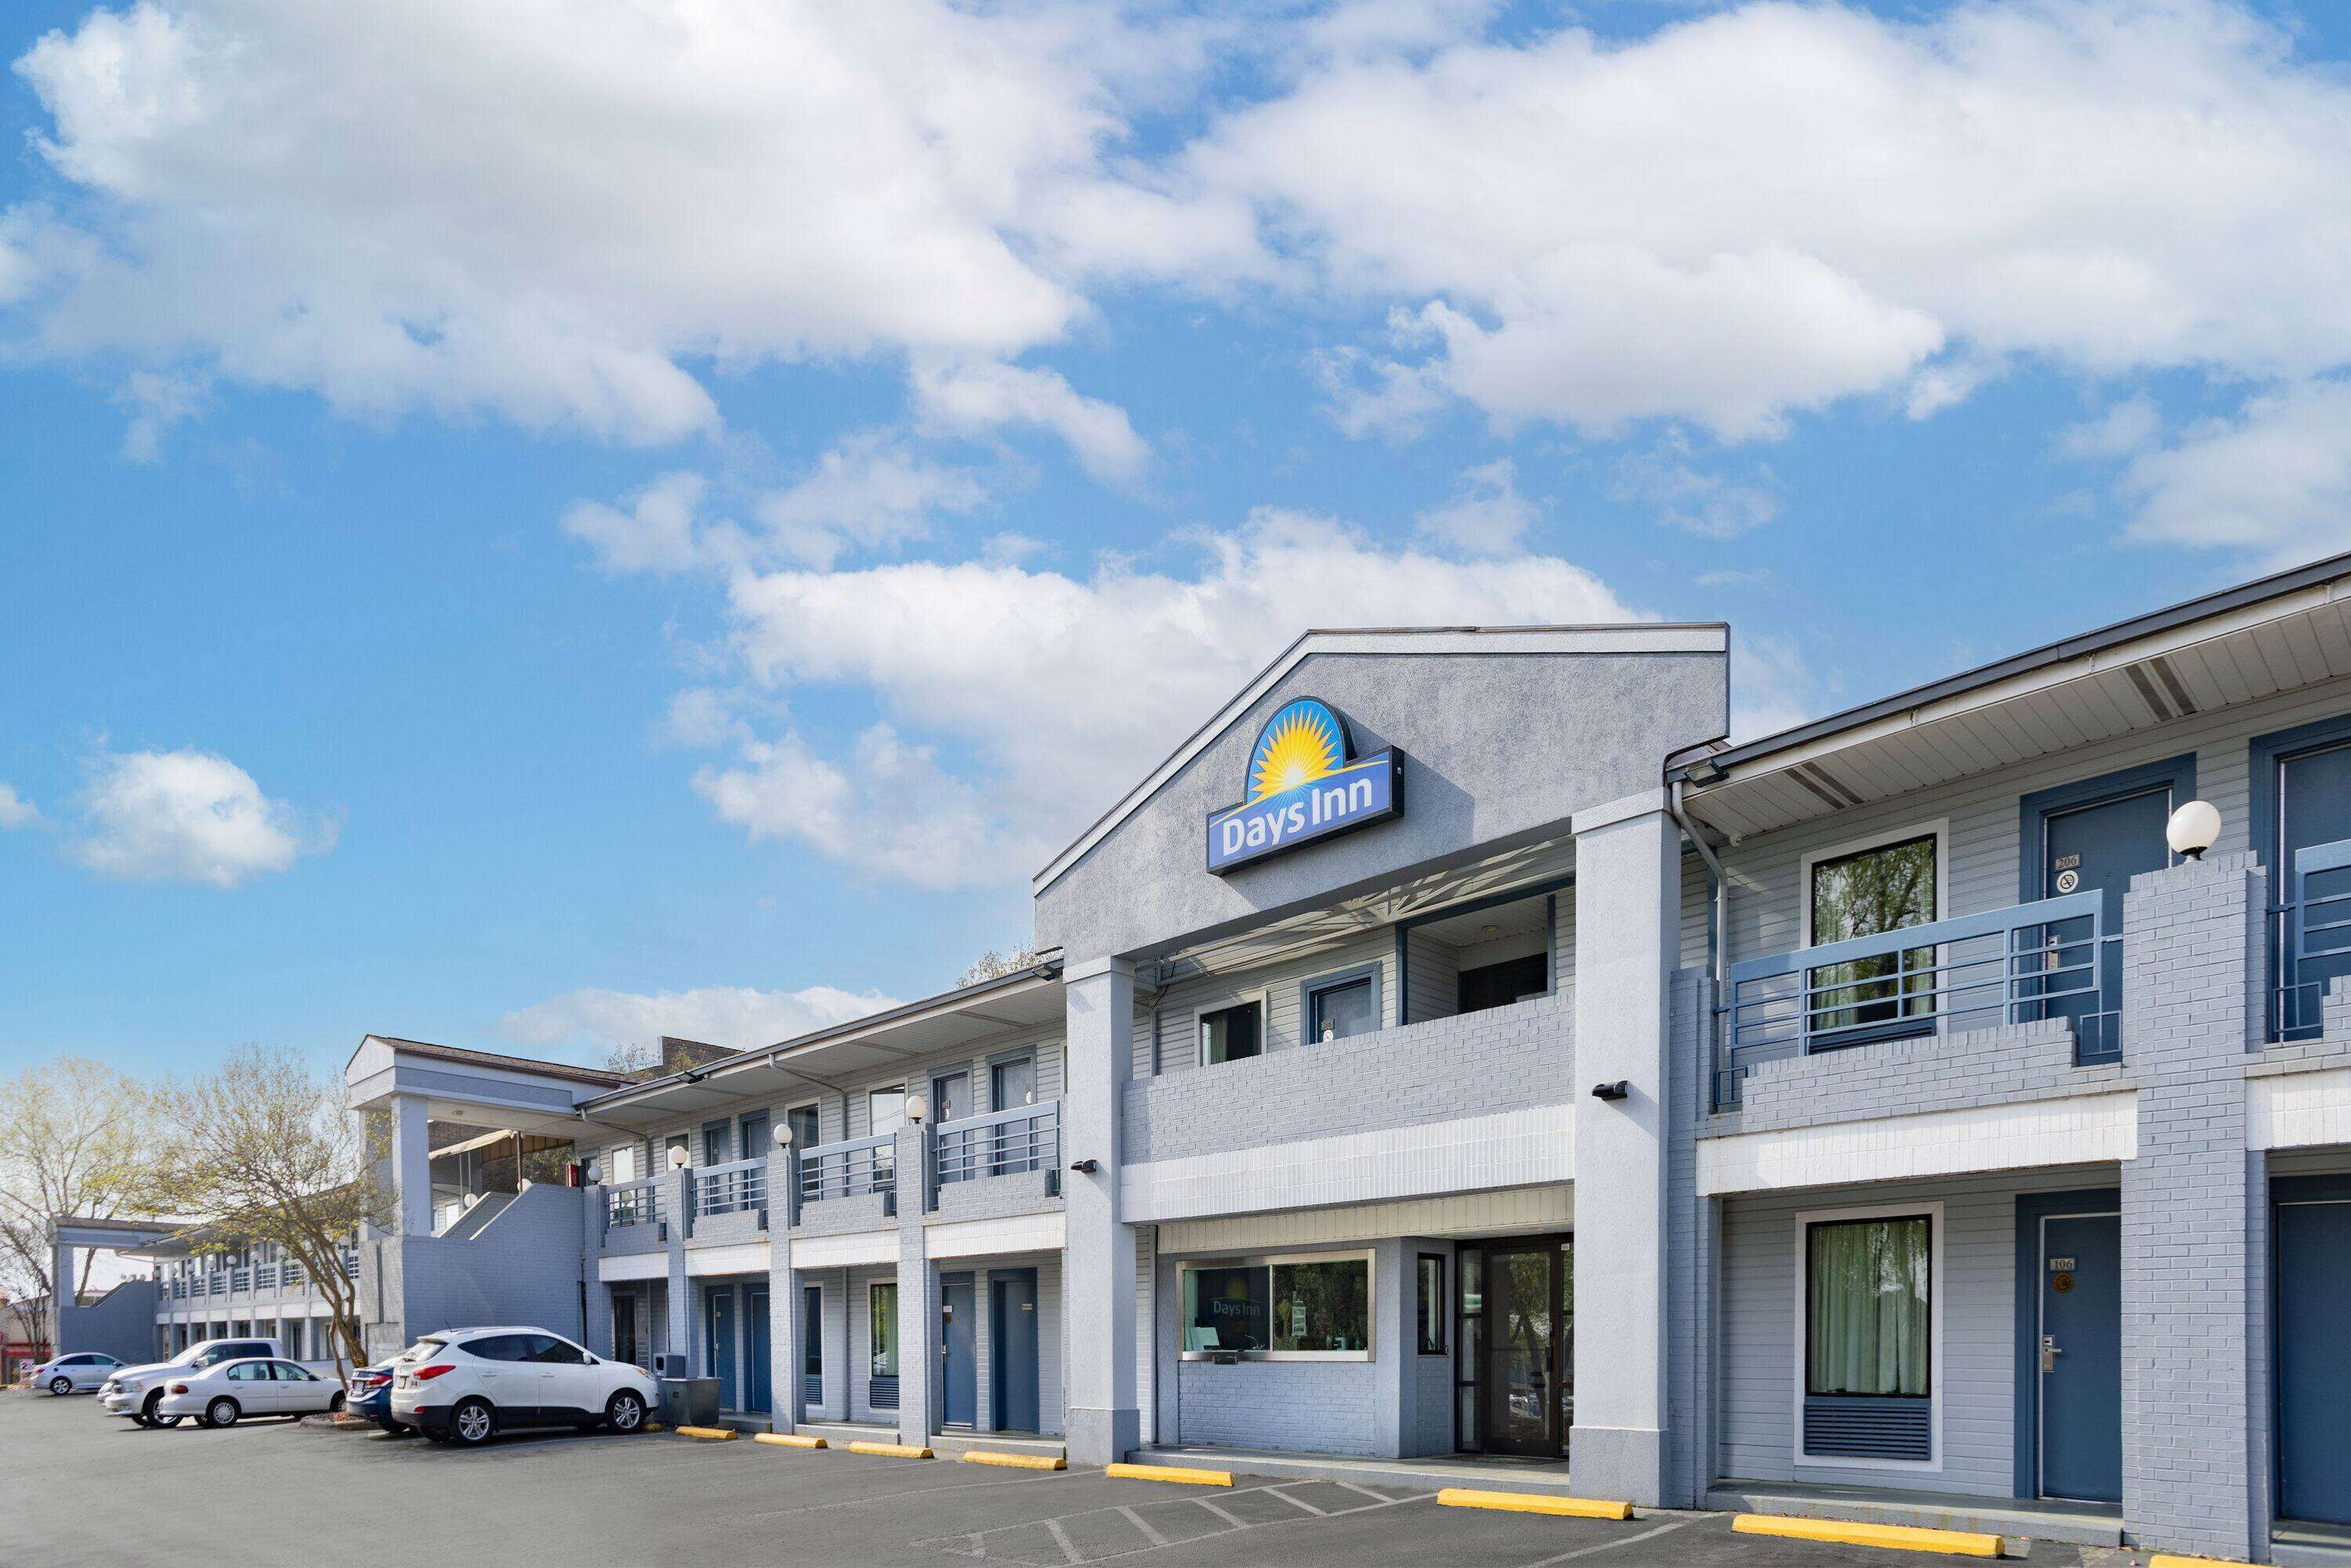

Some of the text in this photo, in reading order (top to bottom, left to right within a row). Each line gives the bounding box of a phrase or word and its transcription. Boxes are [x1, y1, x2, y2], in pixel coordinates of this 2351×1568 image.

[1223, 777, 1372, 856] Days Inn
[2057, 856, 2077, 868] 206
[2053, 1258, 2073, 1269] 106
[1213, 1300, 1261, 1316] Days Inn
